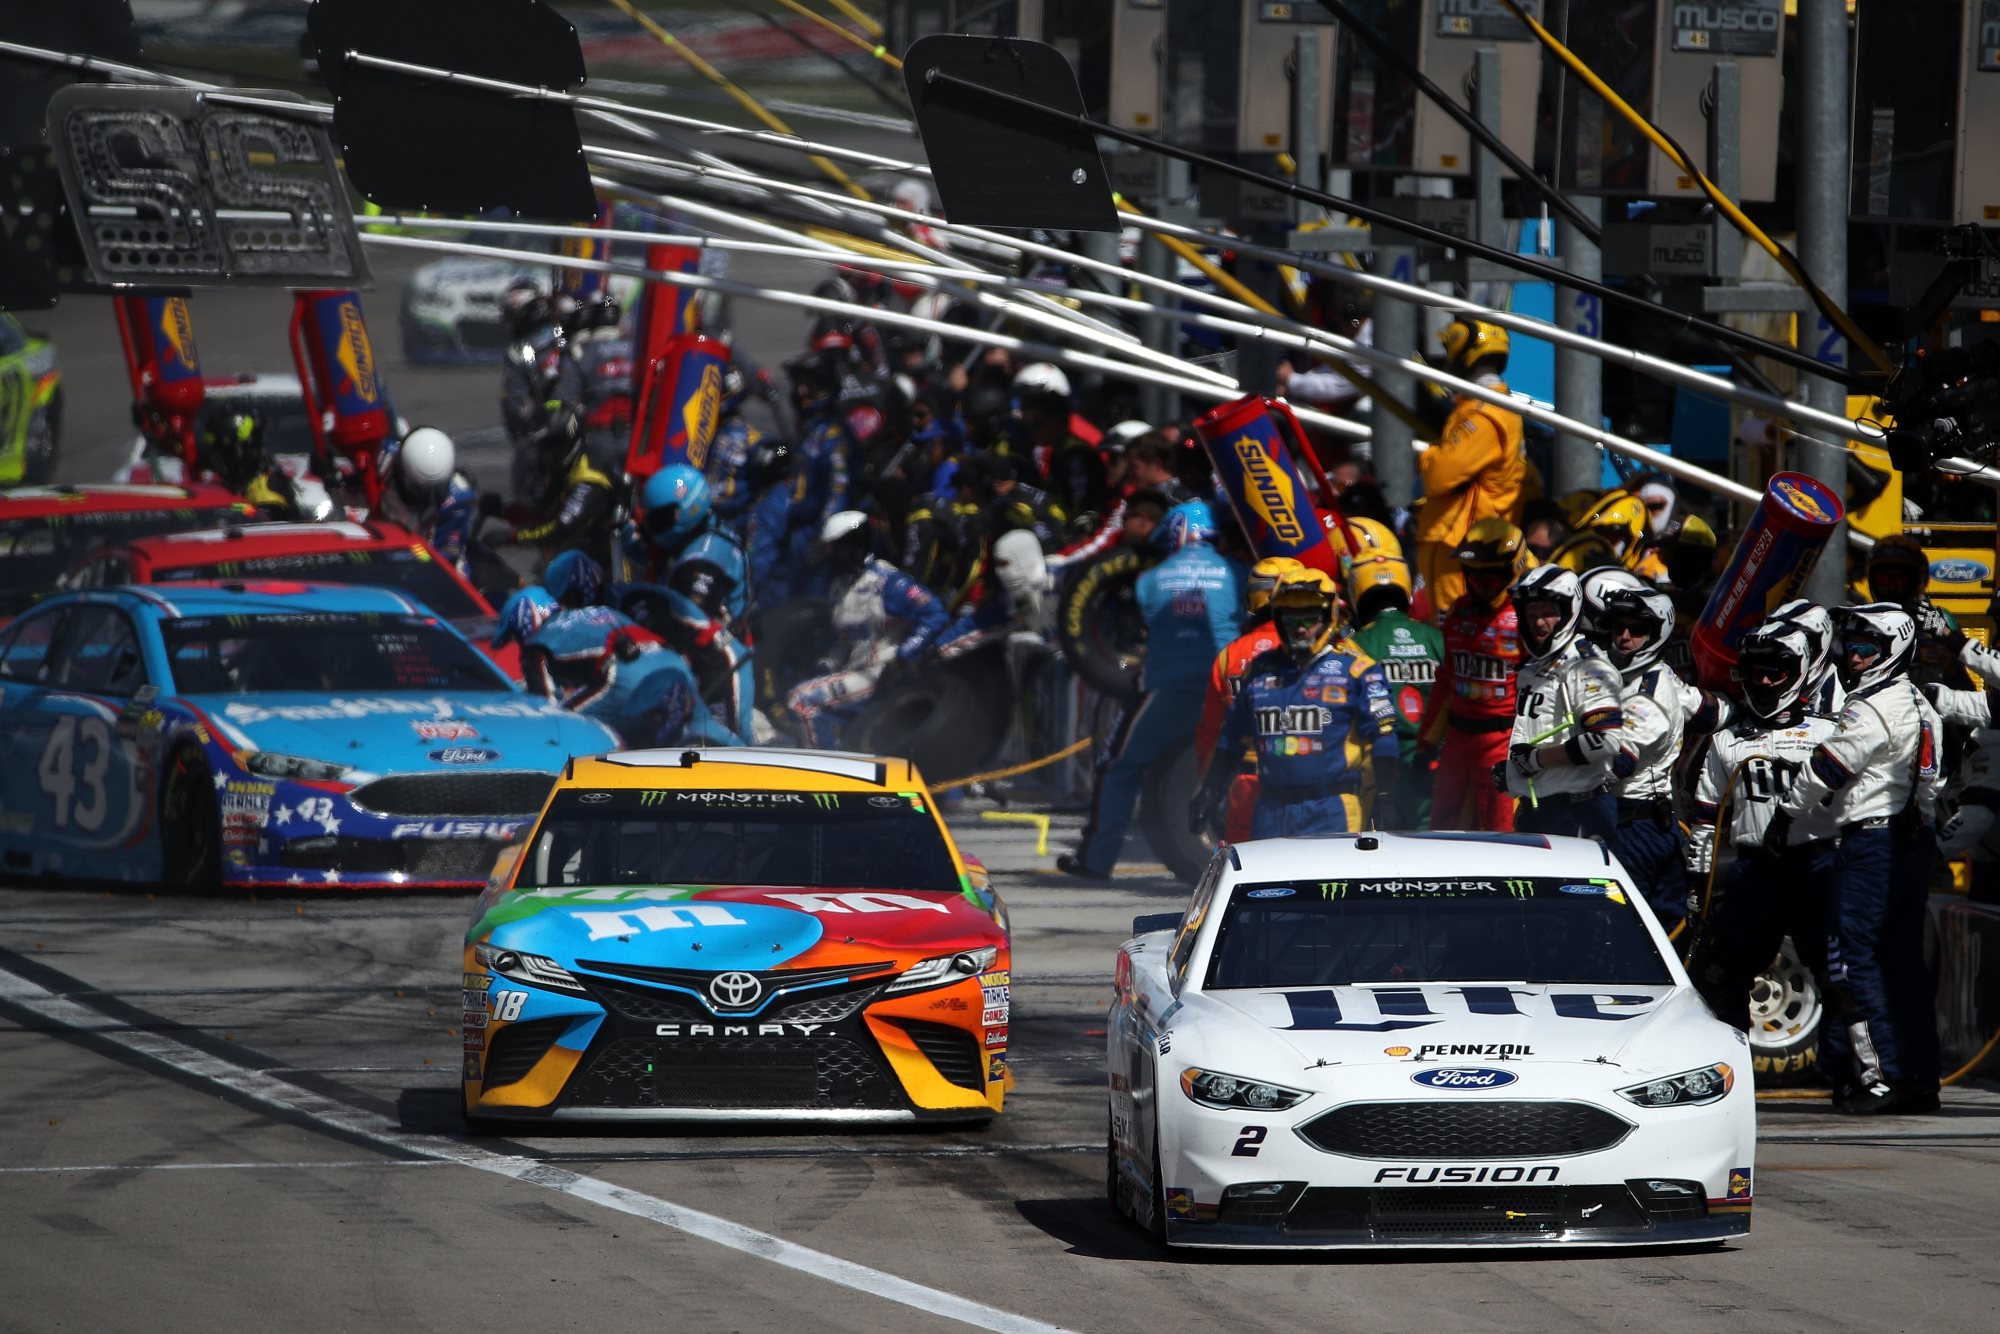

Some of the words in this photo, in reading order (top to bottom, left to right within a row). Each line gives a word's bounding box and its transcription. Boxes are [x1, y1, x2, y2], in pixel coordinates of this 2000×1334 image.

[1238, 444, 1301, 543] SUNOCO
[1936, 563, 1977, 580] Ford
[38, 716, 110, 832] 43
[677, 791, 804, 804] MONSTER
[297, 797, 333, 822] 43
[1256, 888, 1288, 897] Ford
[1359, 880, 1497, 894] MONSTER
[1569, 885, 1602, 895] Ford
[980, 971, 1010, 987] MOOG
[492, 990, 529, 1022] 18
[656, 1024, 822, 1036] CAMRY
[1420, 1044, 1535, 1056] PENNZOIL
[1431, 1069, 1496, 1087] Ford
[1231, 1125, 1268, 1157] 2
[1374, 1166, 1560, 1184] FUSION
